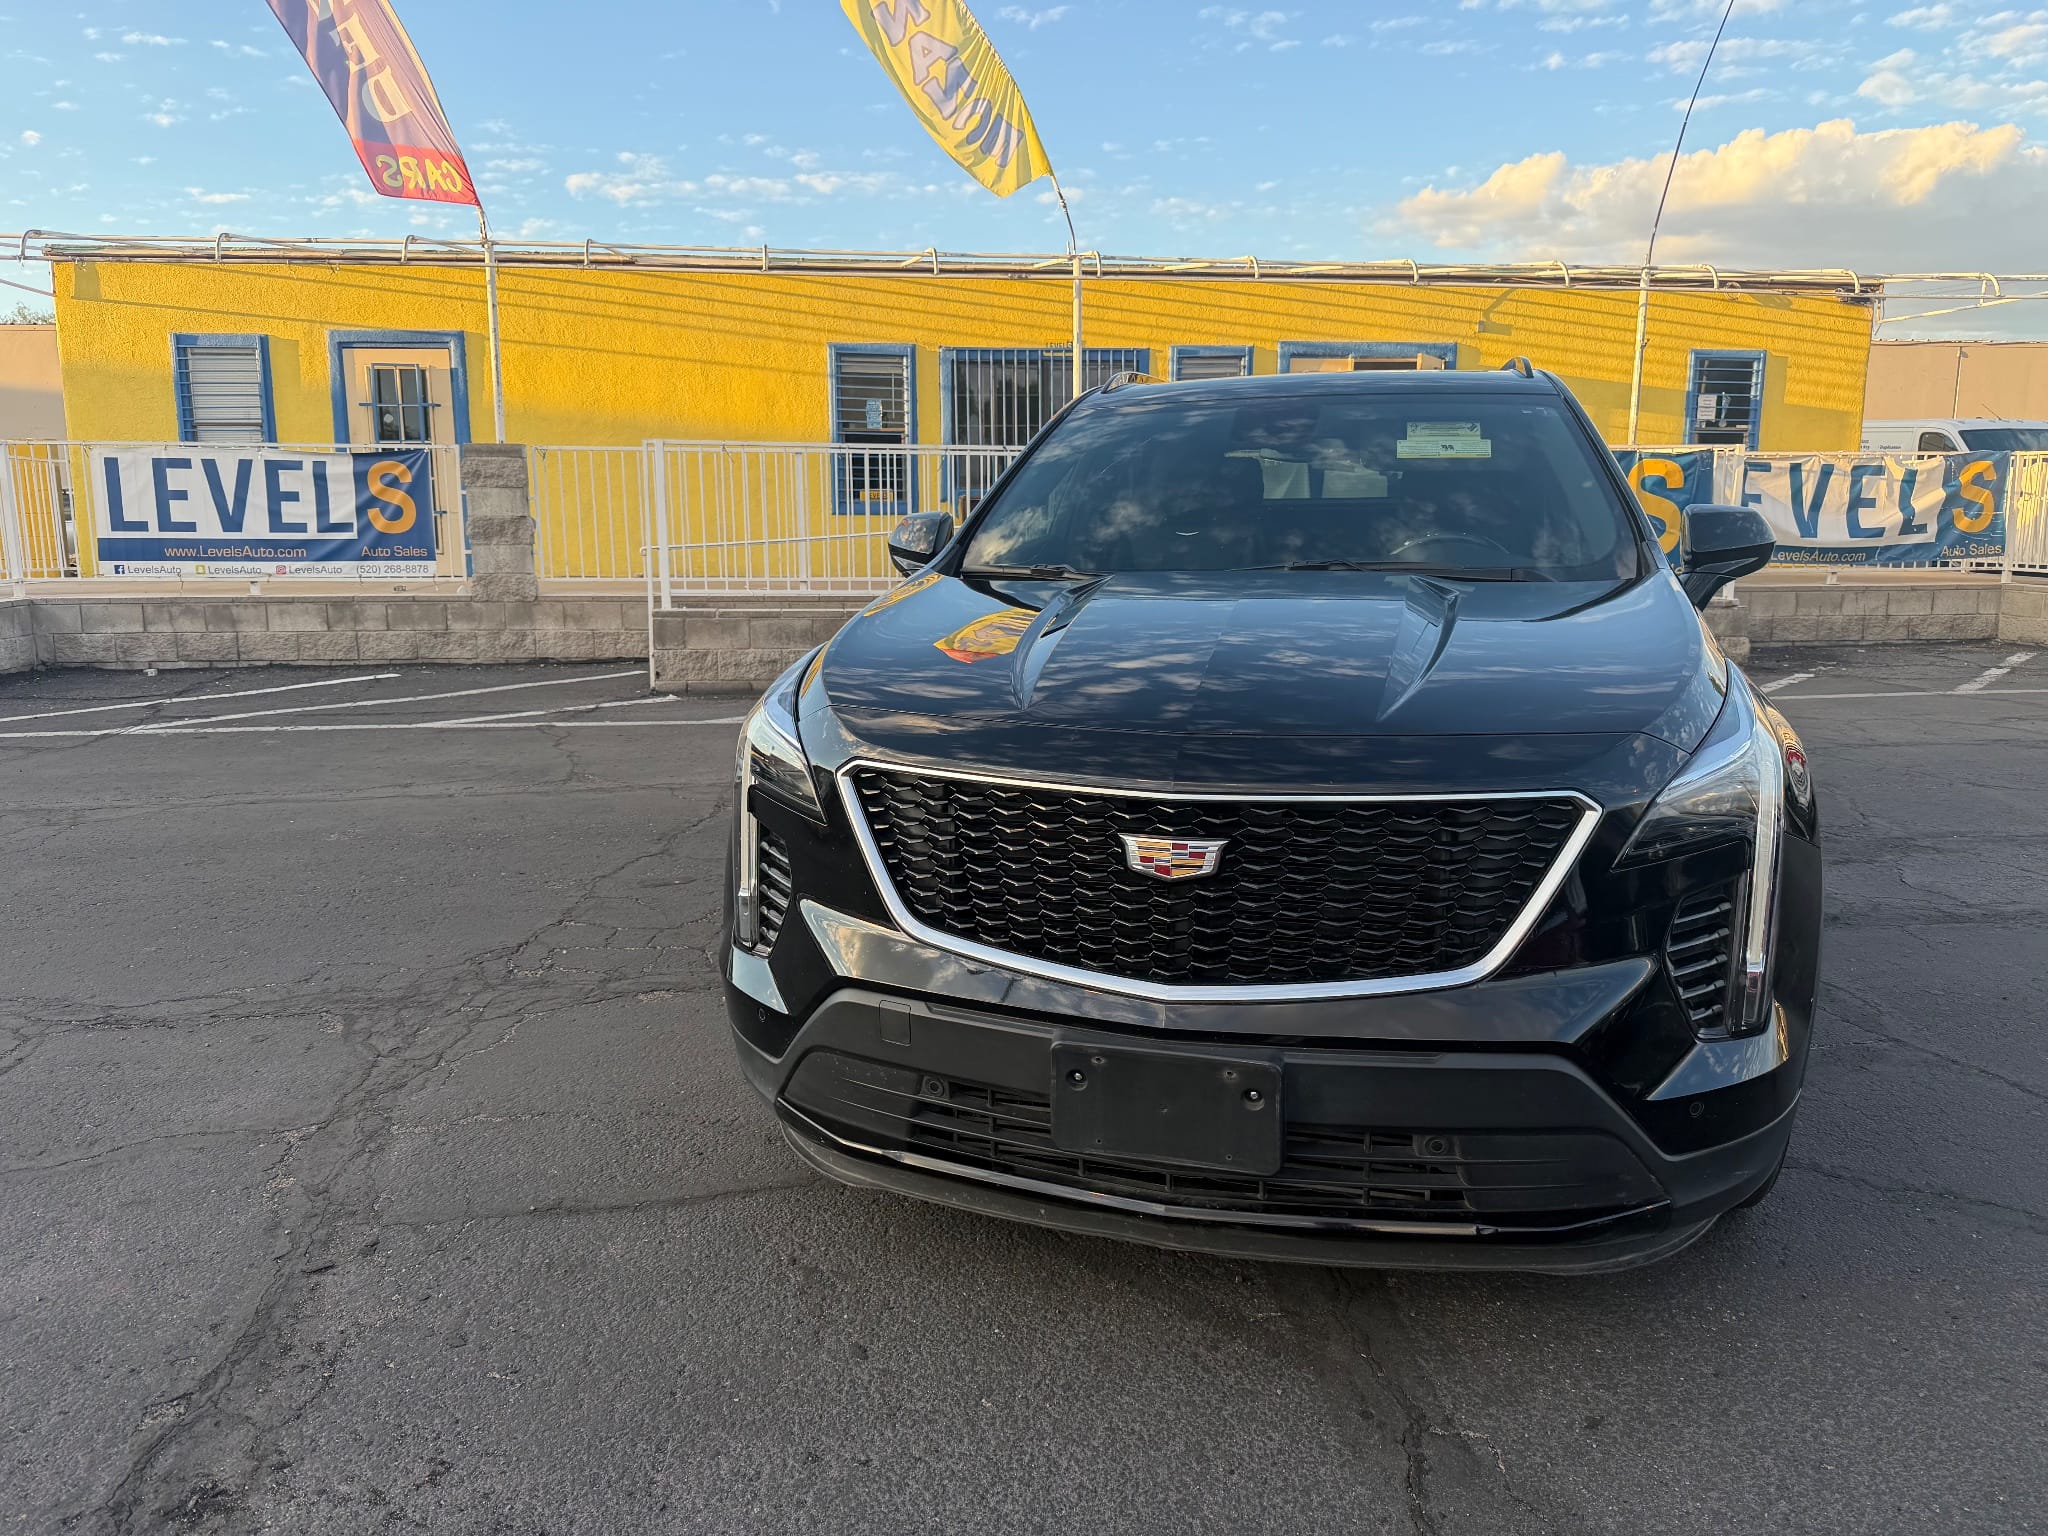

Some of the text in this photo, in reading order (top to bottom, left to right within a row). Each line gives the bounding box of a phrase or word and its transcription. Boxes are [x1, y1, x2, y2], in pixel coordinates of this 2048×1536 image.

[103, 457, 417, 534] LEVELS
[1741, 461, 1997, 538] EVELS
[164, 546, 307, 558] www.LevelsAuto.com
[361, 545, 428, 557] Auto Sales
[1941, 543, 2002, 557] Auto Sales
[127, 565, 182, 574] LevelsAuto
[208, 565, 262, 574] LevelsAuto
[289, 565, 343, 574] LevelsAuto
[356, 564, 429, 575] (520) 268-8878
